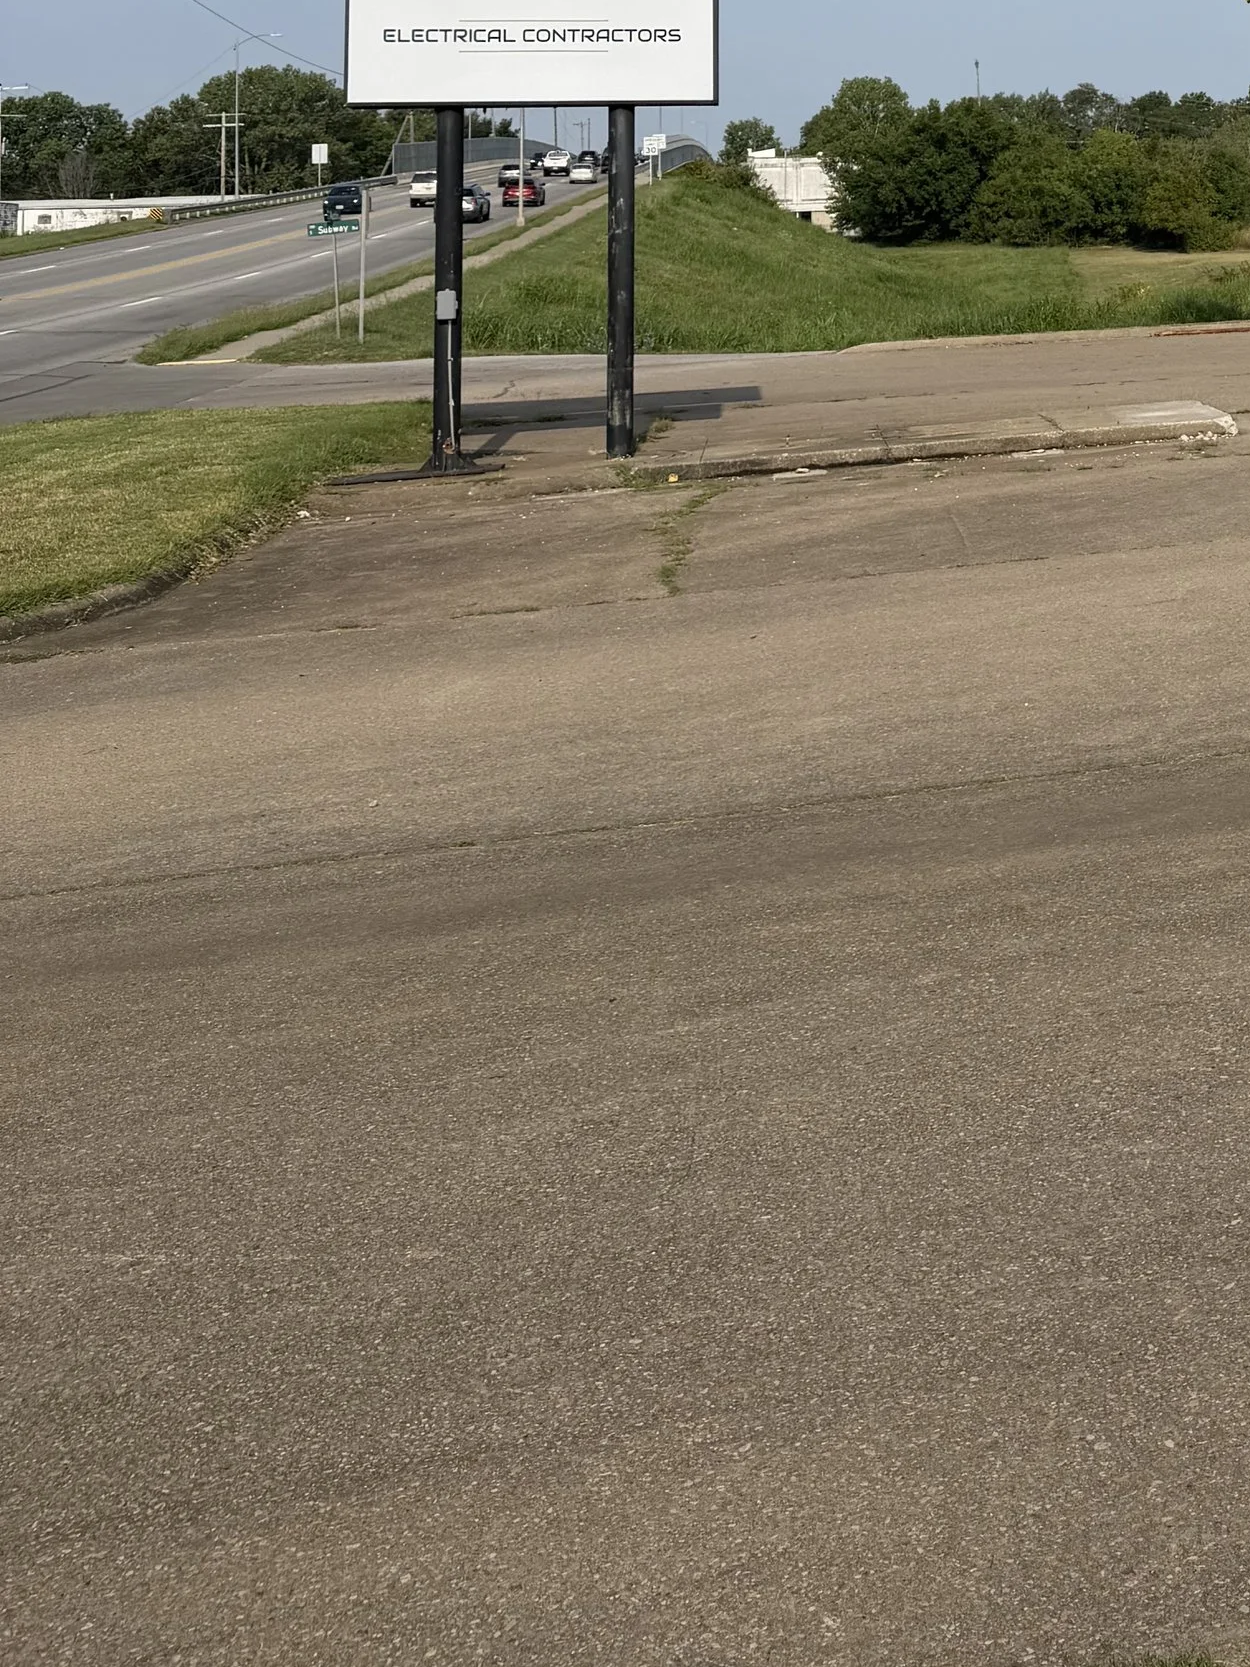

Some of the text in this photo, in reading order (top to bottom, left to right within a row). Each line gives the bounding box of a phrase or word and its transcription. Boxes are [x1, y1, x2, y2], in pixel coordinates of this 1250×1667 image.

[383, 28, 682, 43] ELECTRICAL CONTRACTORS
[317, 225, 349, 235] Subway
